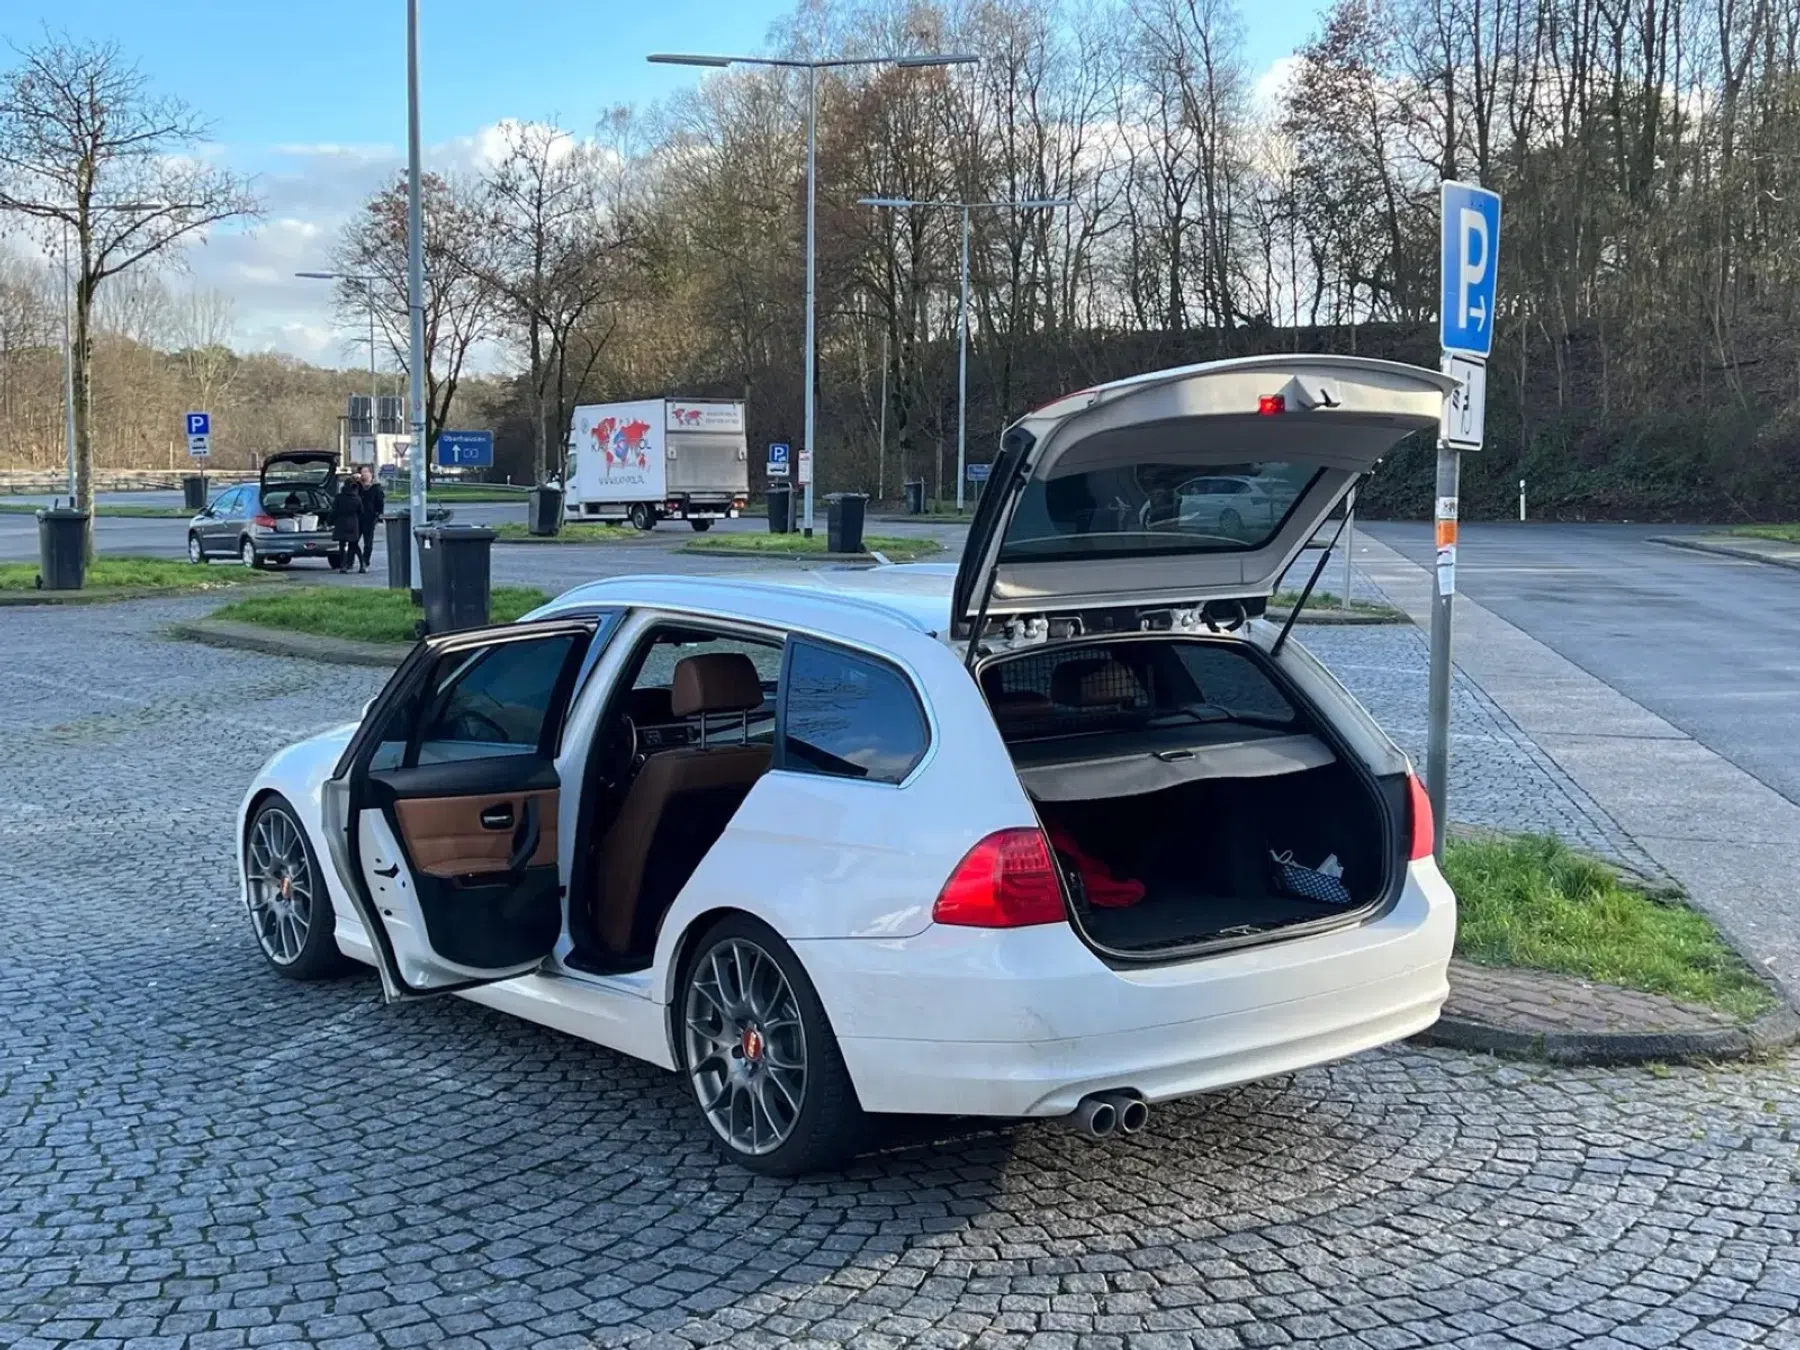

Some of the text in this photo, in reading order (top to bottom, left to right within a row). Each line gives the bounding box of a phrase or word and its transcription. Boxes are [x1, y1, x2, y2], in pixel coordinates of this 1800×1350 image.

[1459, 207, 1488, 329] P
[191, 416, 204, 433] P
[774, 447, 785, 461] P
